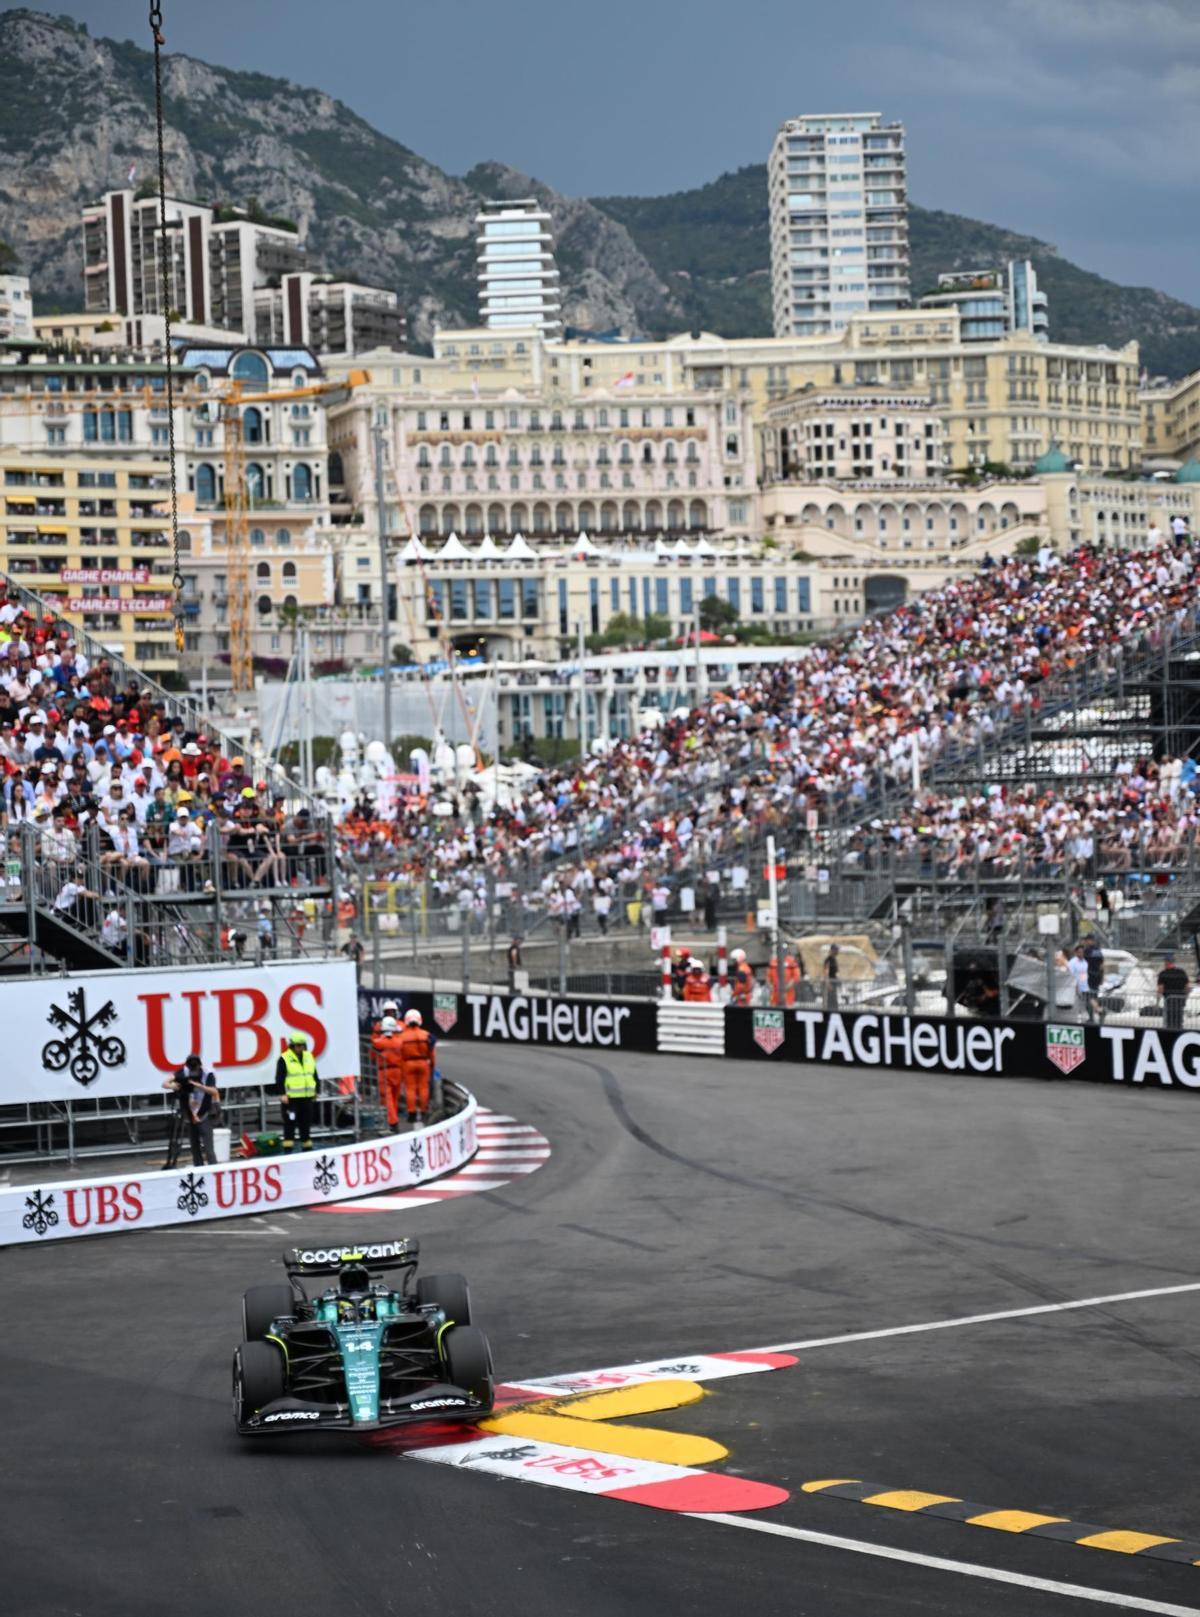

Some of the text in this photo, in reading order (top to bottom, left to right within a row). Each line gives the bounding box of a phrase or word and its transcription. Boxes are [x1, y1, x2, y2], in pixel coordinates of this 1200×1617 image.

[70, 599, 119, 611] CHARLES
[137, 982, 327, 1072] UBS
[755, 1012, 782, 1027] TAG
[1049, 1028, 1082, 1044] TAG
[341, 1145, 392, 1188] UBS
[214, 1163, 283, 1209] UBS
[63, 1181, 143, 1228] UBS
[345, 1341, 374, 1352] 14
[412, 1399, 466, 1411] aramco
[264, 1411, 320, 1422] aramco
[524, 1454, 635, 1481] UBS
